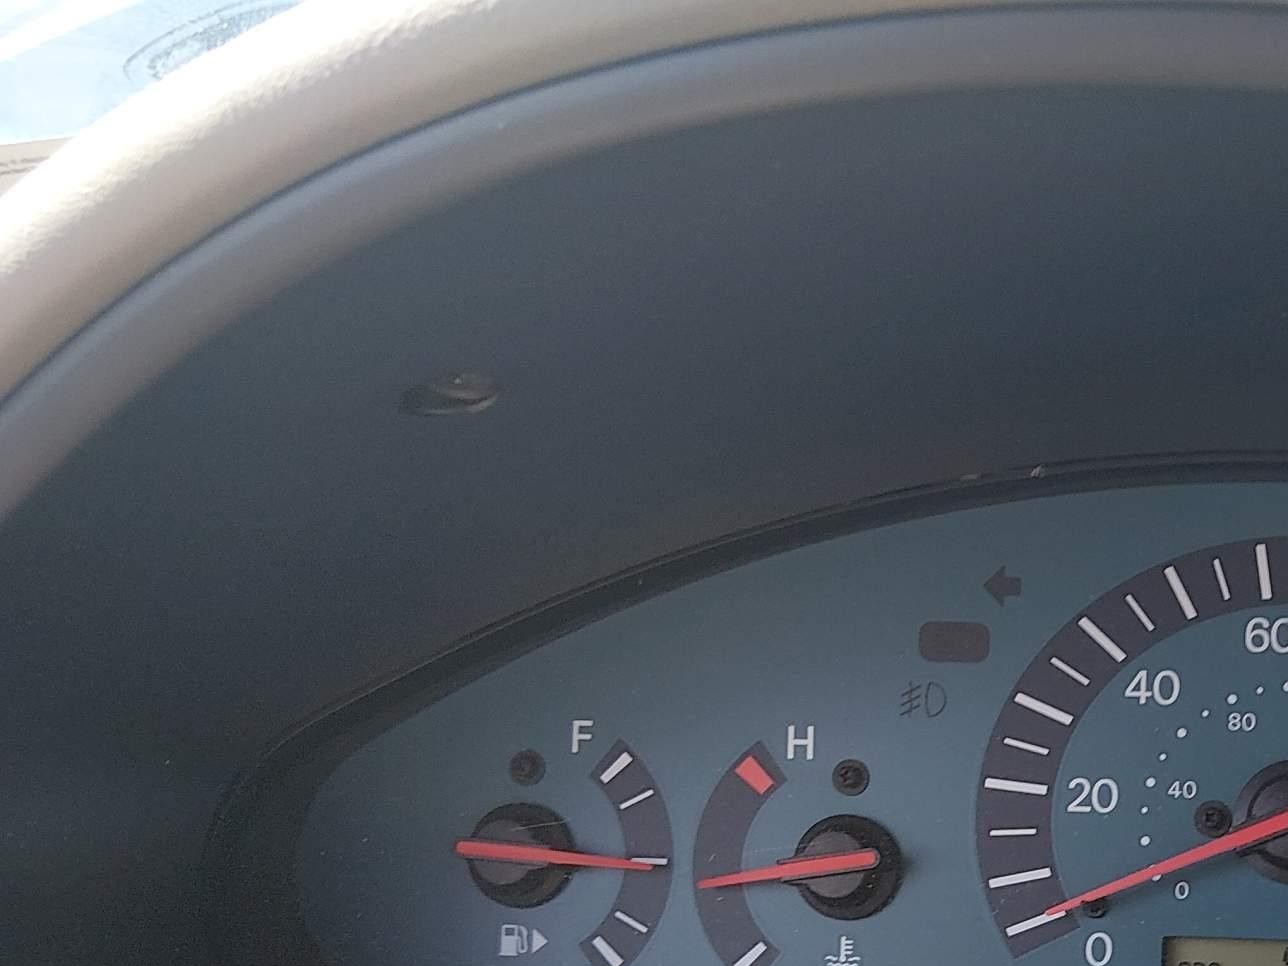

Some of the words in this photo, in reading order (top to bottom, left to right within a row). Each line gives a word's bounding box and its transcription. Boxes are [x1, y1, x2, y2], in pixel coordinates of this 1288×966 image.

[1125, 671, 1179, 705] 40
[572, 720, 593, 752] F
[1229, 713, 1255, 731] 80
[787, 726, 814, 760] H
[1068, 778, 1118, 813] 20
[1168, 781, 1196, 798] 40
[1175, 882, 1190, 900] 0
[1086, 933, 1112, 966] 0
